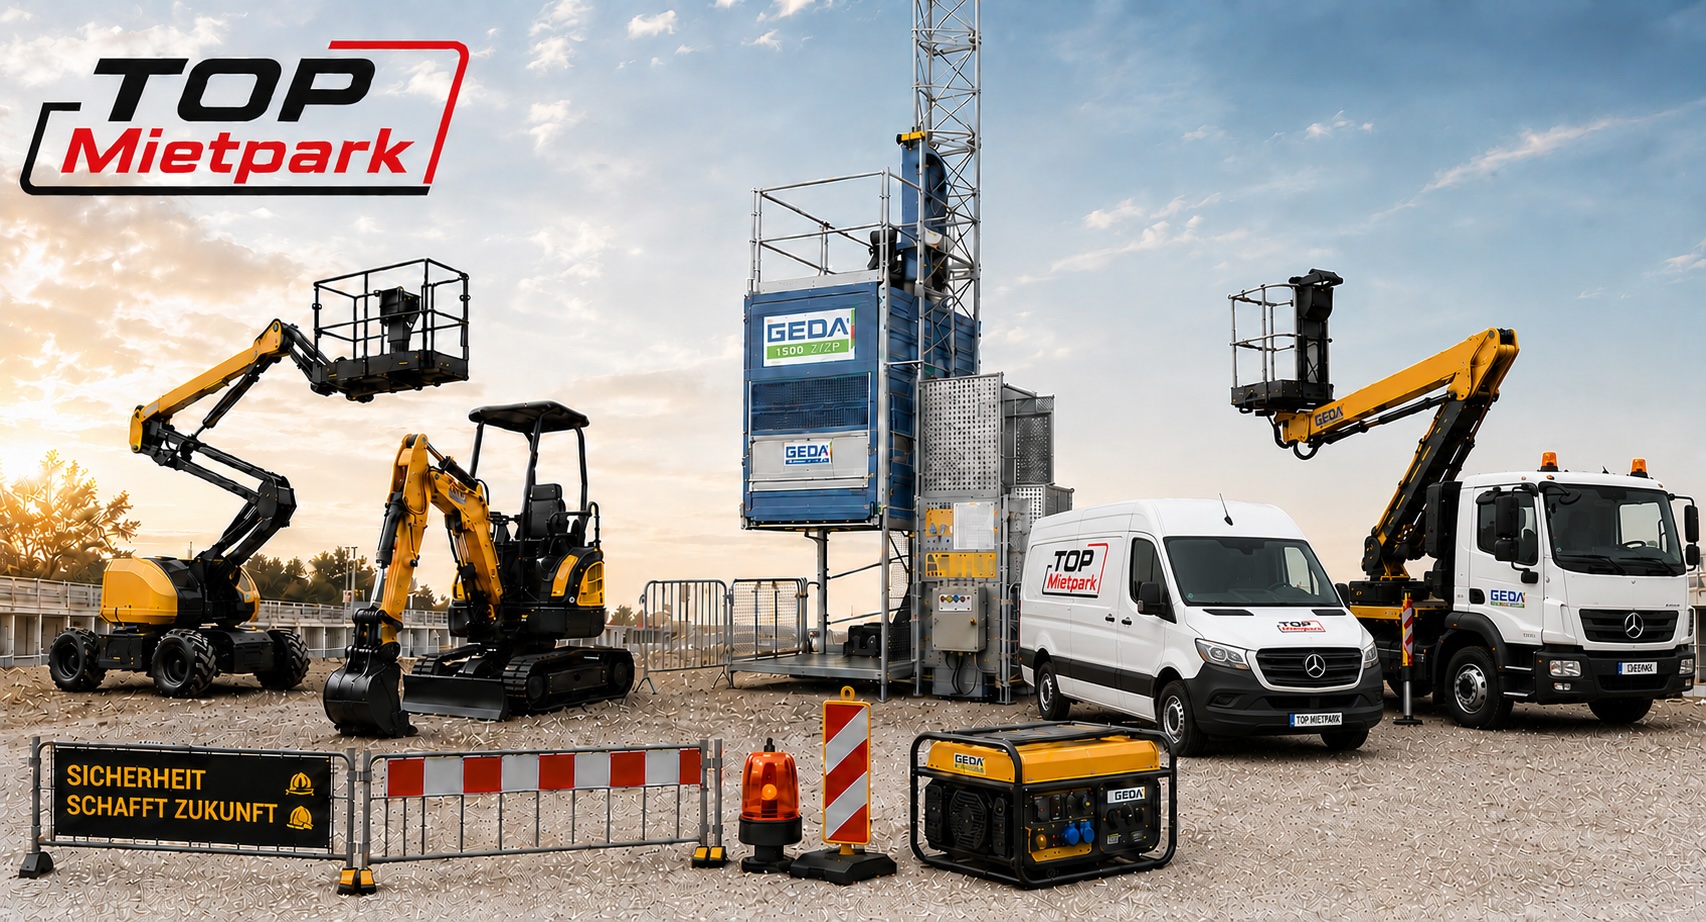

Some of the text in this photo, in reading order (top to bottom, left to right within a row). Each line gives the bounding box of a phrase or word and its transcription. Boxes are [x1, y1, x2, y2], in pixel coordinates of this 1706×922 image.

[767, 317, 849, 343] GEDA
[776, 346, 804, 356] 1500
[1314, 406, 1344, 427] GEDA
[785, 444, 829, 458] GEDA
[1054, 549, 1094, 572] TOP
[1046, 573, 1097, 593] Mietpark
[1490, 589, 1525, 603] GEDA
[1296, 715, 1309, 725] TOP
[955, 754, 984, 767] GEDA
[66, 764, 206, 791] SICHERHEIT
[1114, 789, 1144, 801] GEDA
[66, 794, 278, 824] SCHAFFT ZUKUNFT
